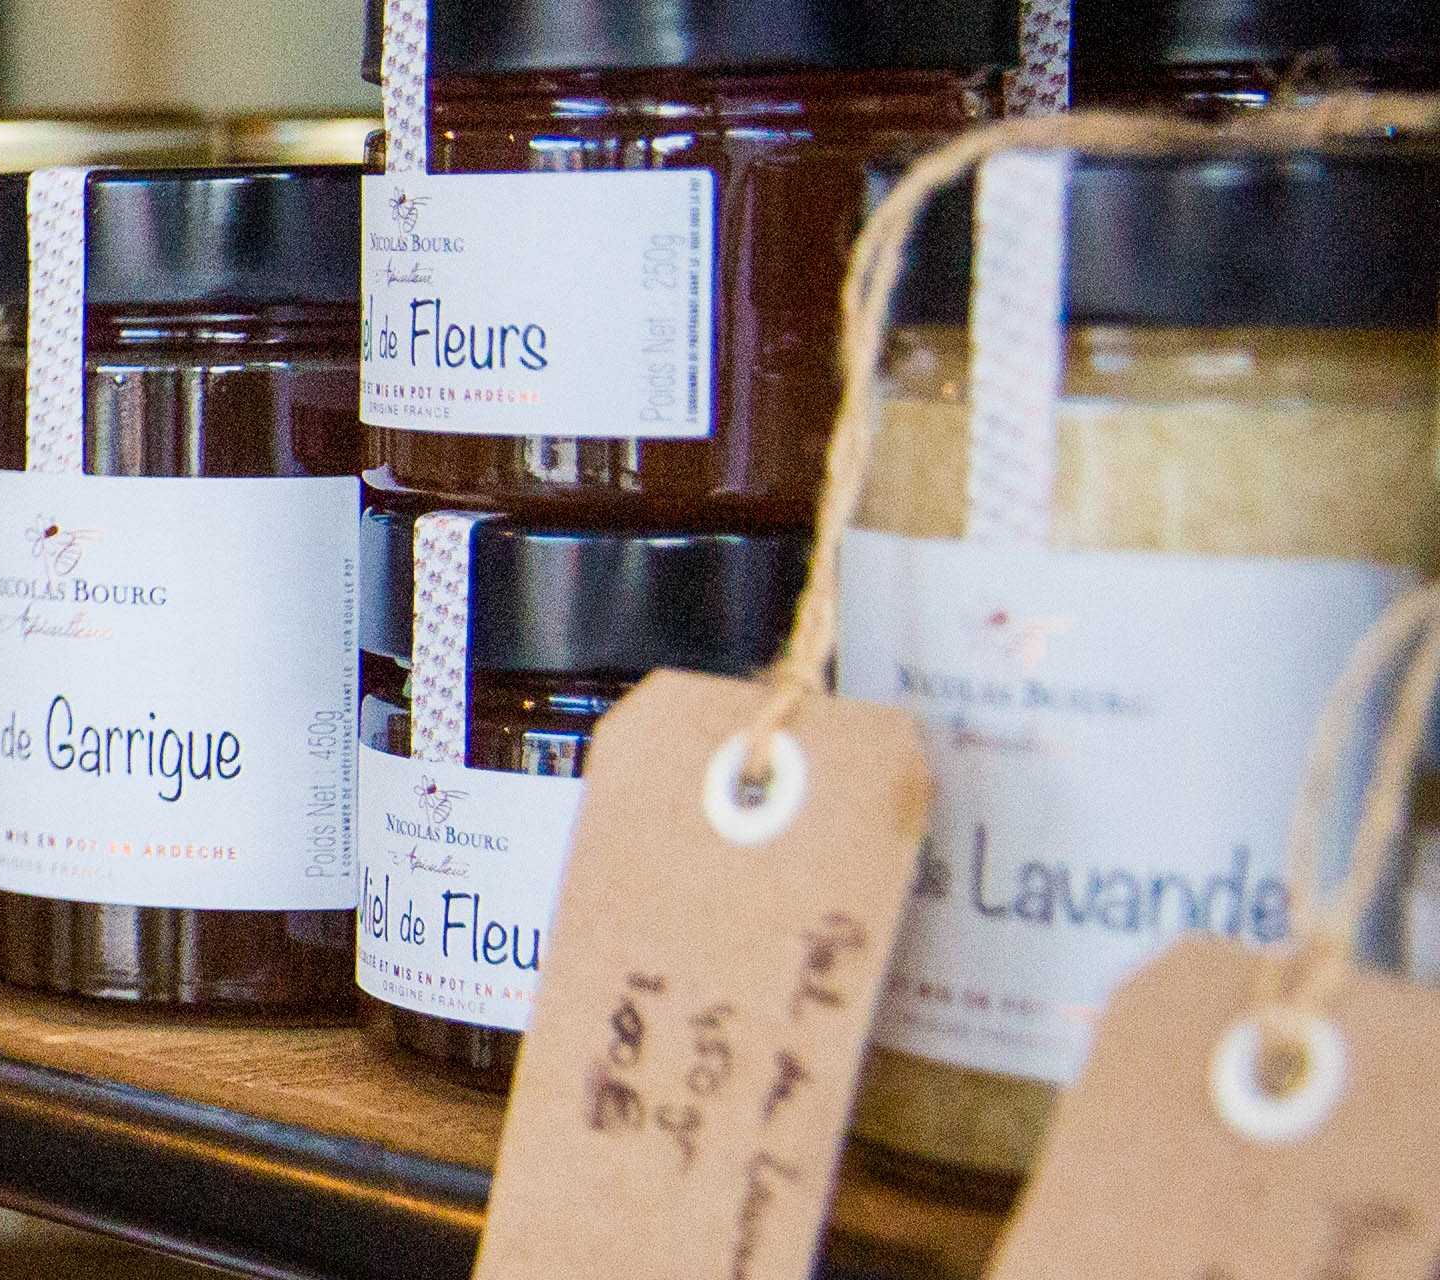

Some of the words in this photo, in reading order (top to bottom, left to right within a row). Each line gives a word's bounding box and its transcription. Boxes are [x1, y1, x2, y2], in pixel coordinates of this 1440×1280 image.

[370, 232, 408, 253] NICOLAS
[411, 233, 465, 253] BOURG
[641, 234, 687, 290] 250g
[379, 314, 398, 360] de
[409, 296, 548, 372] Fleurs
[393, 384, 405, 398] EN
[410, 385, 432, 400] POT
[439, 387, 456, 401] EN
[403, 404, 451, 419] FRANCE
[73, 579, 168, 607] BOURG
[0, 711, 32, 761] de
[46, 693, 241, 802] Garrigue
[307, 710, 345, 761] 450g
[305, 783, 337, 817] Net
[66, 835, 98, 854] POT
[109, 839, 133, 856] EN
[143, 840, 238, 861] ARDÈCHE
[304, 824, 337, 878] Poids
[385, 811, 440, 842] NICOLAS
[445, 824, 509, 853] BOURG
[971, 821, 1292, 945] Lavande
[399, 899, 425, 946] de
[441, 889, 541, 971] Fleu
[382, 978, 424, 1003] ORIGINE
[430, 993, 487, 1015] FRANCE
[393, 964, 412, 981] MIS
[418, 970, 433, 986] EN
[440, 975, 465, 993] POT
[475, 982, 494, 998] EN
